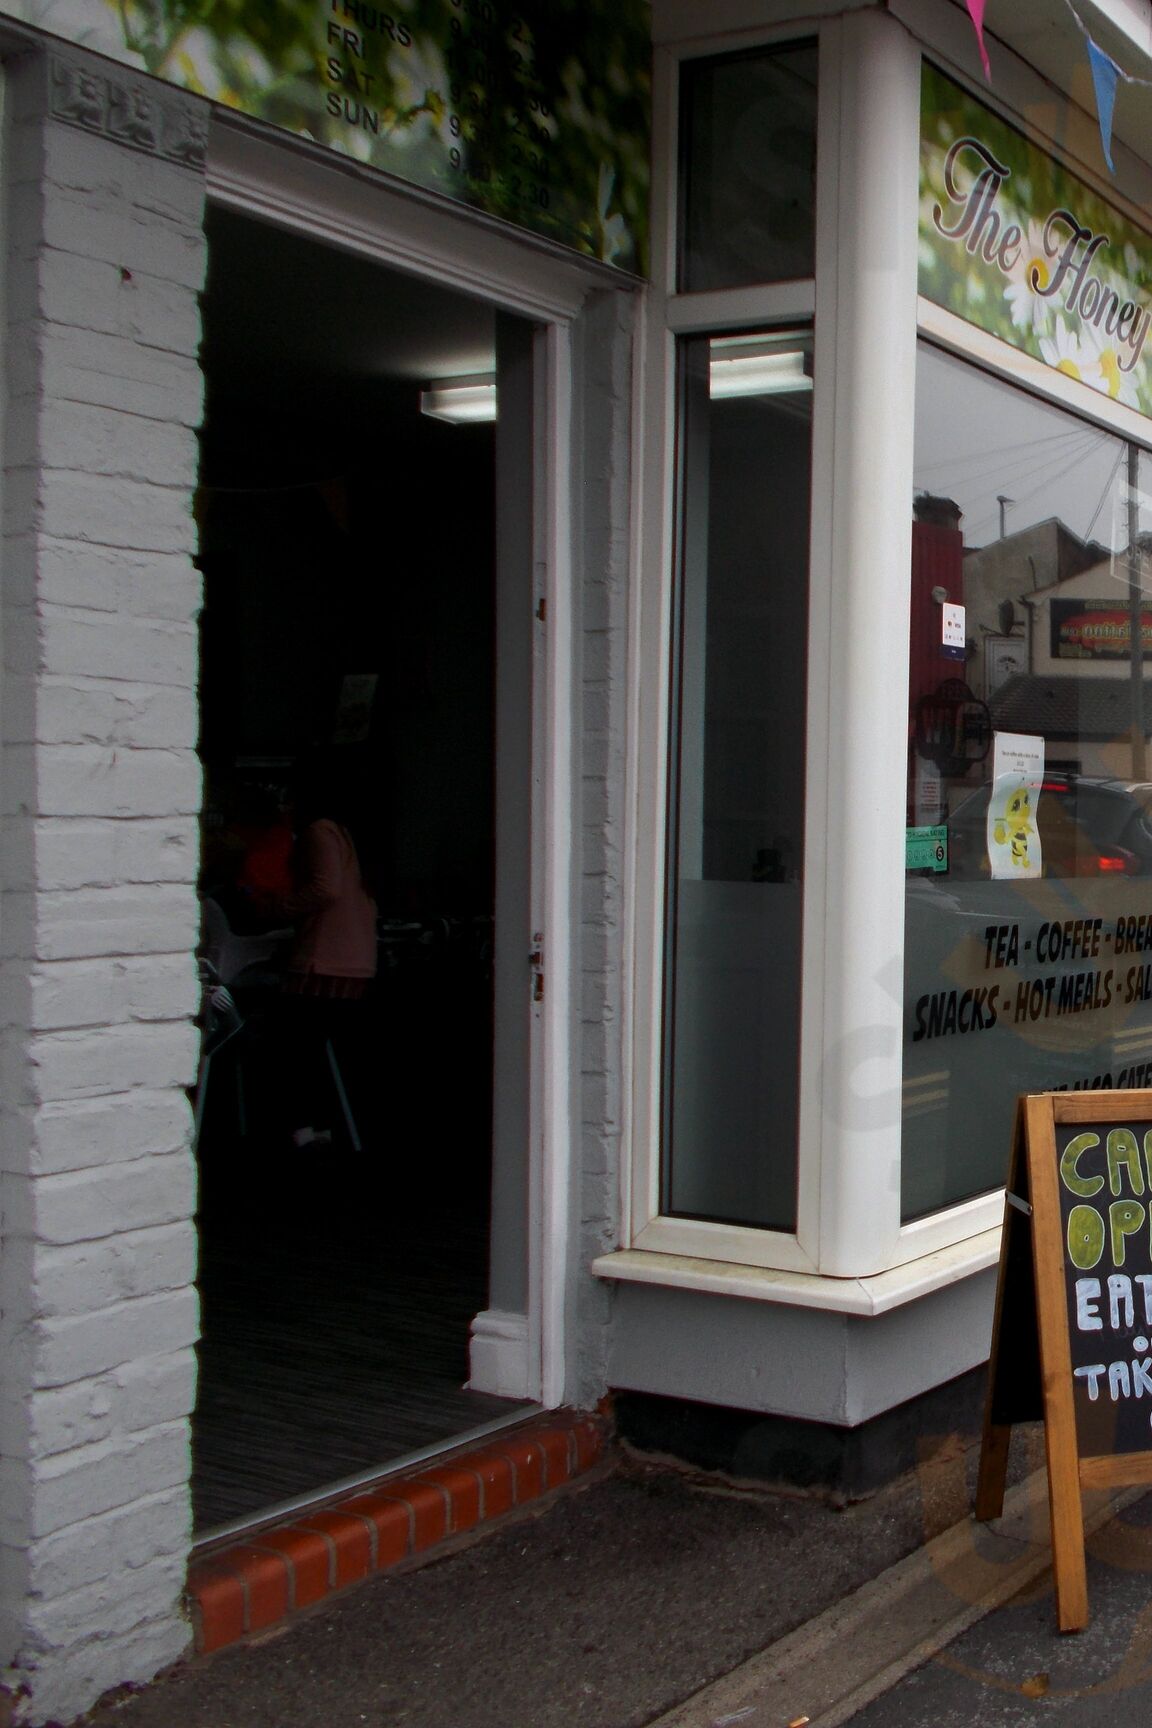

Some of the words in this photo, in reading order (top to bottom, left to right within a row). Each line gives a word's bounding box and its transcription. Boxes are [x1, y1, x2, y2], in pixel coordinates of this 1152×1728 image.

[327, 21, 366, 59] FRI
[326, 57, 376, 97] SAT
[326, 91, 378, 135] SUN
[933, 137, 1022, 272] The
[1030, 209, 1152, 373] Honey
[984, 924, 1019, 969] TEA
[1036, 918, 1103, 964] COFFEE
[912, 984, 1001, 1042] SNACKS
[1014, 976, 1056, 1024] HOT
[1057, 968, 1114, 1016] MEALS
